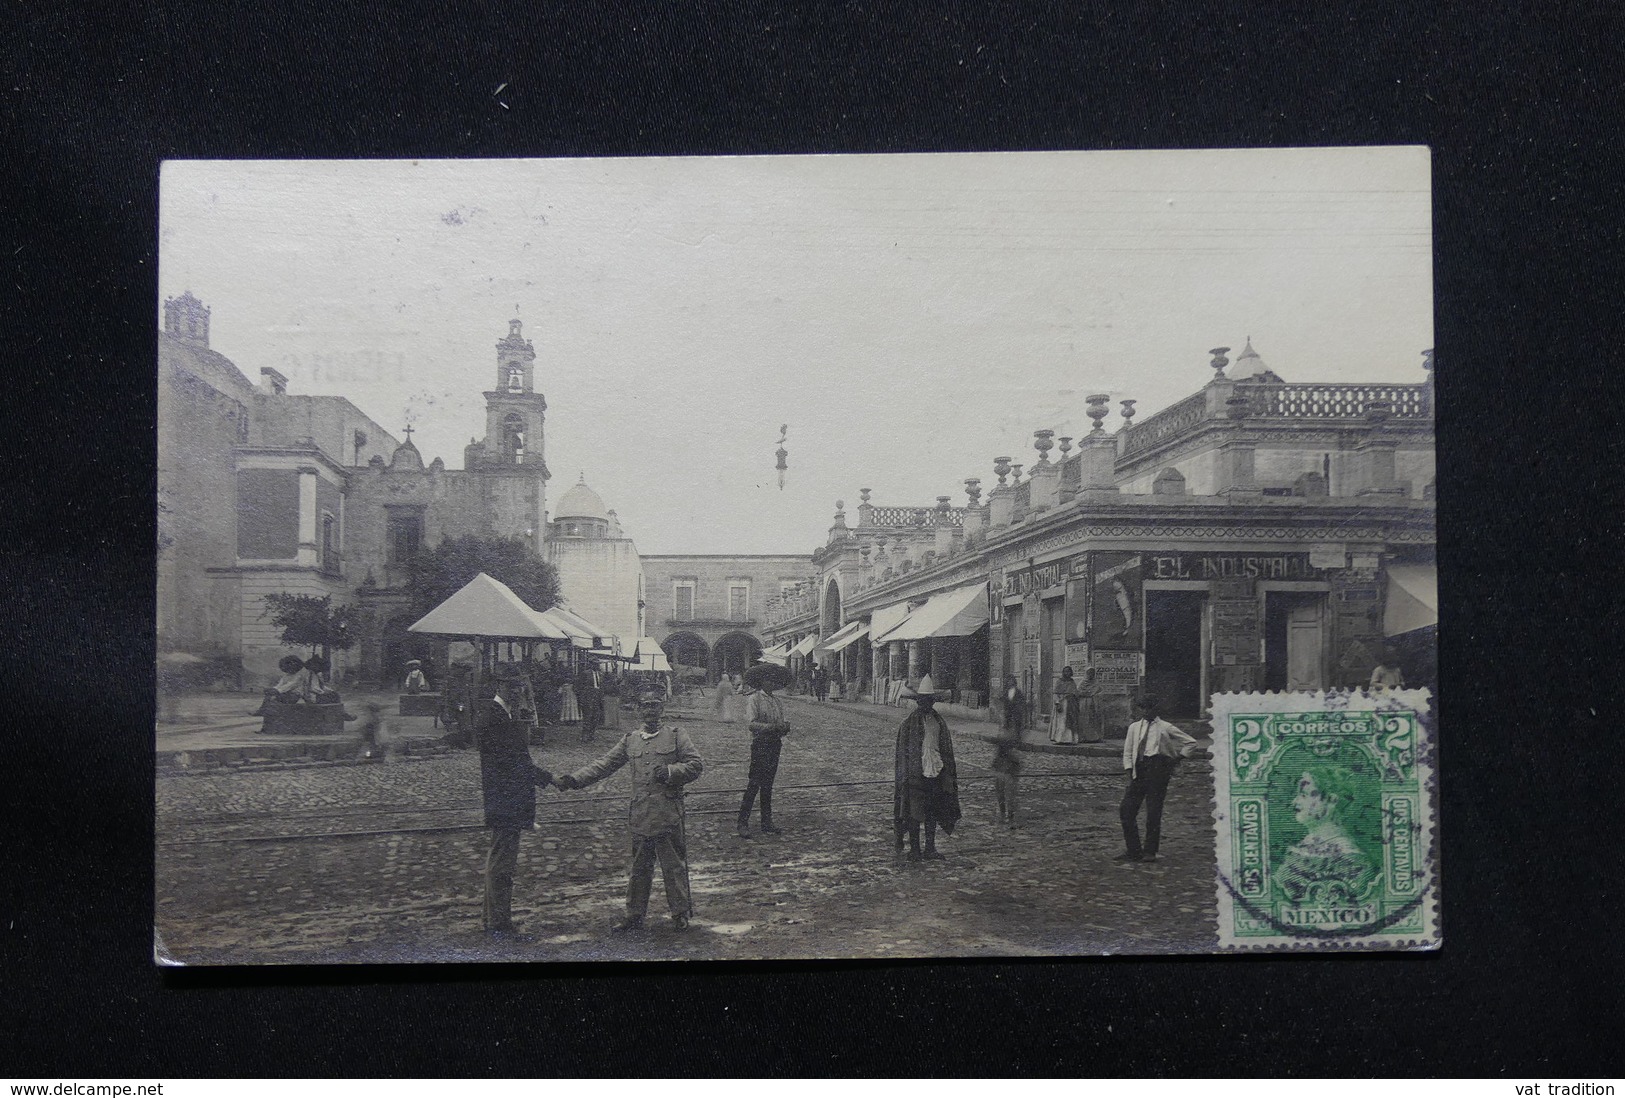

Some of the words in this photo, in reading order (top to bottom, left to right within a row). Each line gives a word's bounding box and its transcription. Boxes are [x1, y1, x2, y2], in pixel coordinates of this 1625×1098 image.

[1153, 557, 1190, 578] EL
[1202, 557, 1316, 578] INDUSTRIAL
[1235, 719, 1261, 751] 2
[1279, 721, 1368, 734] CORREOS
[1386, 717, 1412, 751] 2
[1391, 800, 1409, 825] DOS
[1244, 803, 1260, 867] CENTAVOS
[1391, 827, 1410, 891] CENTAVOS
[1286, 908, 1370, 924] MEXICO
